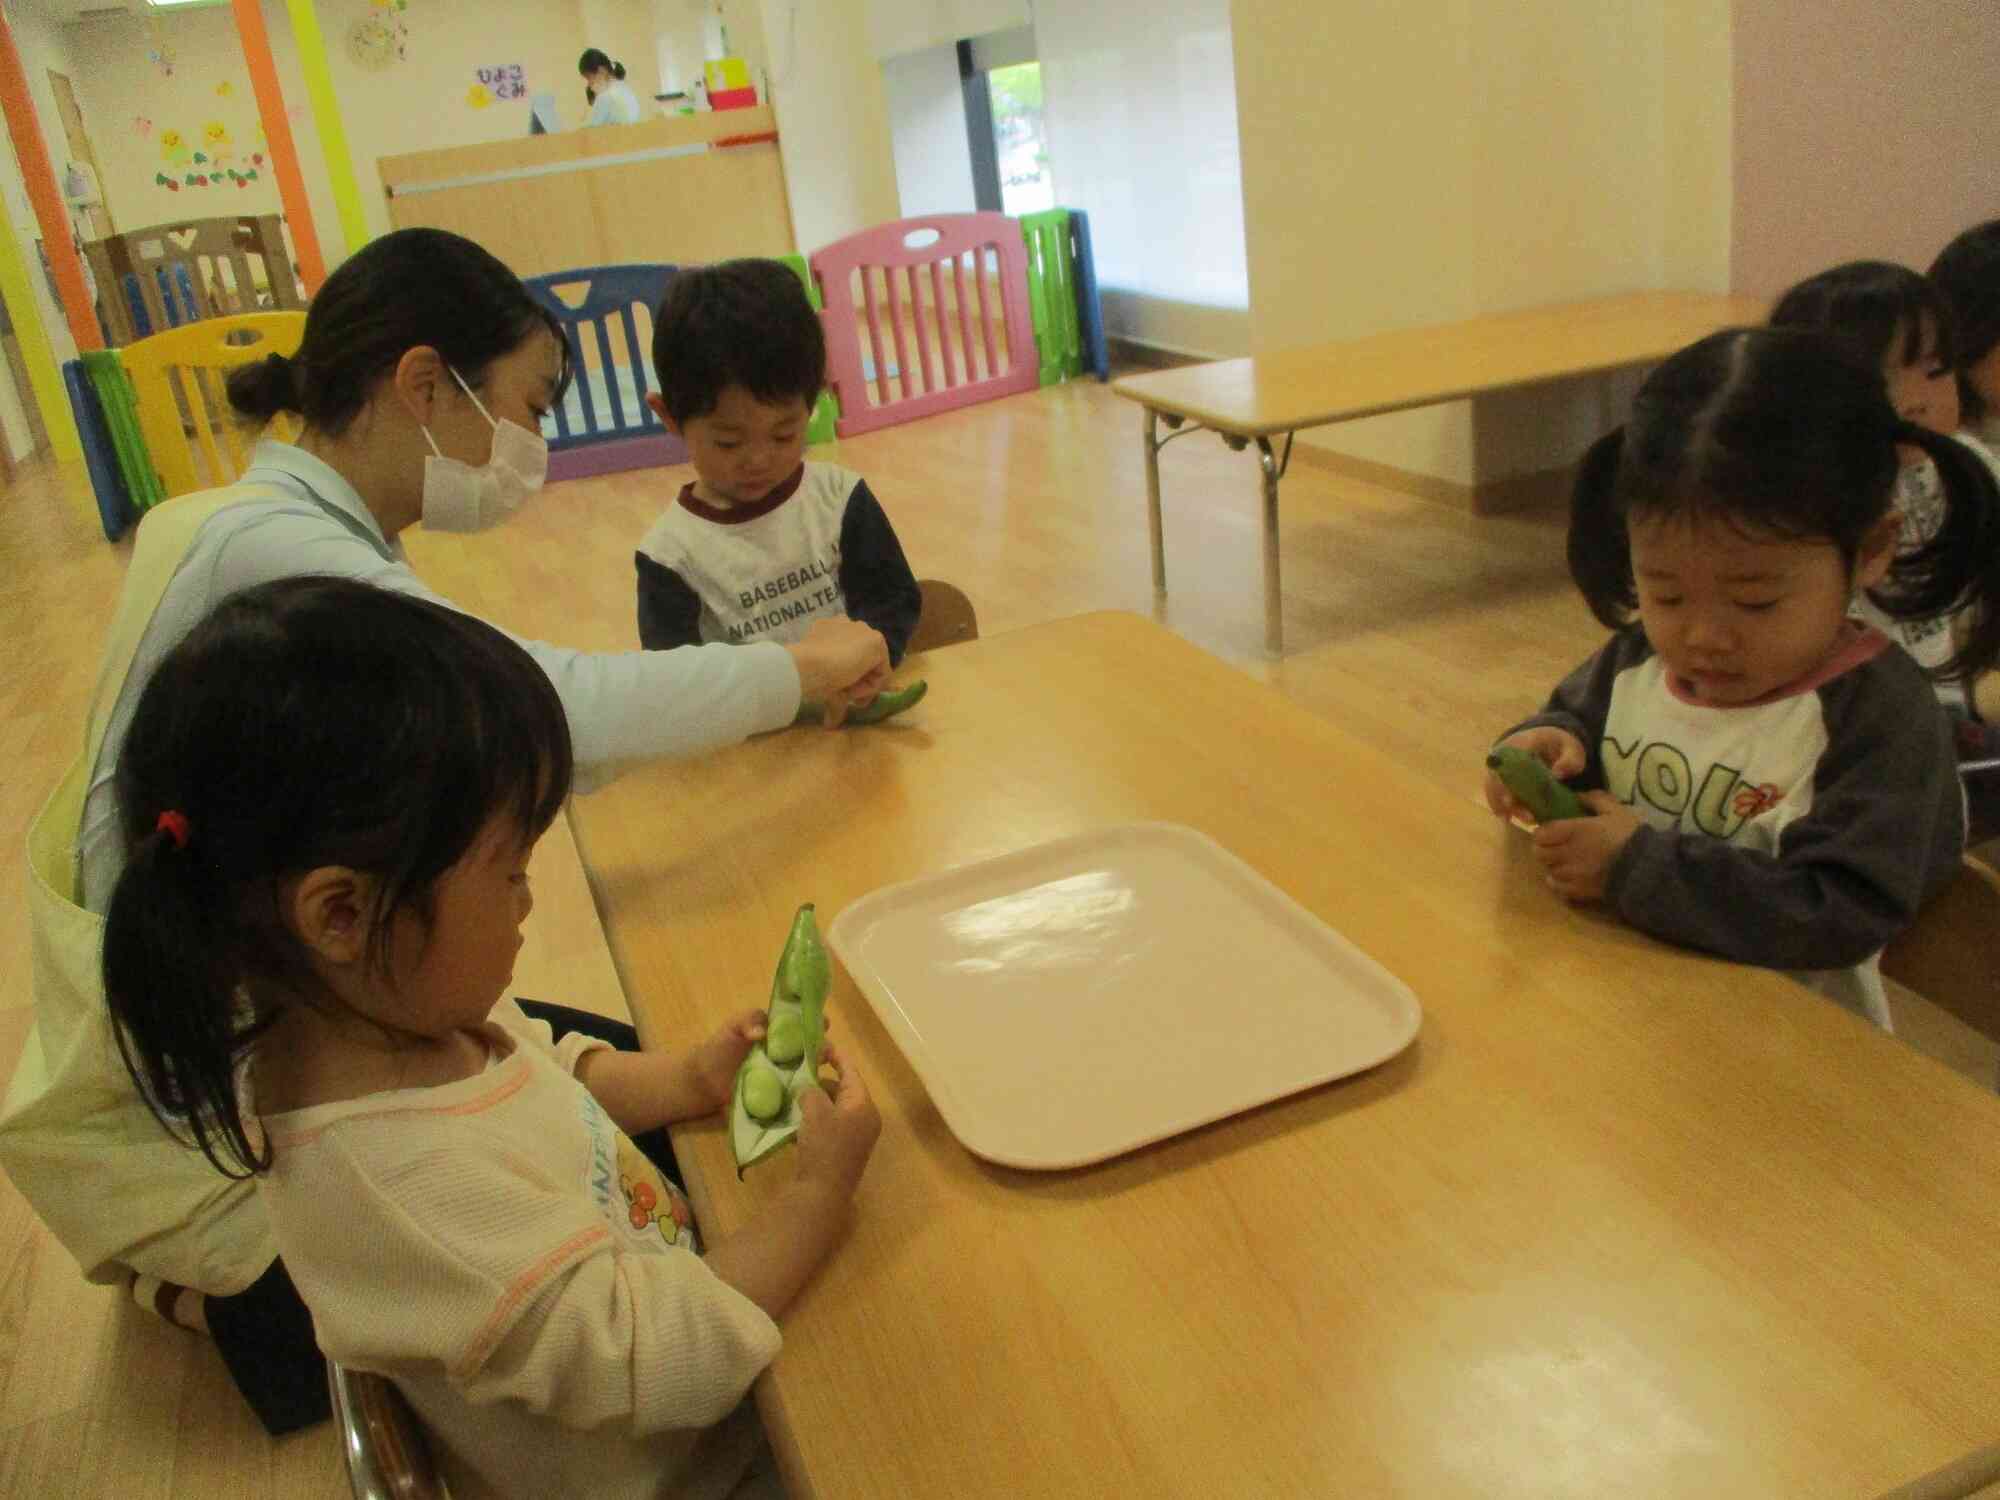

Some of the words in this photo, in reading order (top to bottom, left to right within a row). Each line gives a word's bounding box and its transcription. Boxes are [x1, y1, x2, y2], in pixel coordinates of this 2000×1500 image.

[477, 64, 523, 84] ひよこ
[739, 559, 833, 609] BASEBALL
[728, 596, 816, 640] NATIONAL
